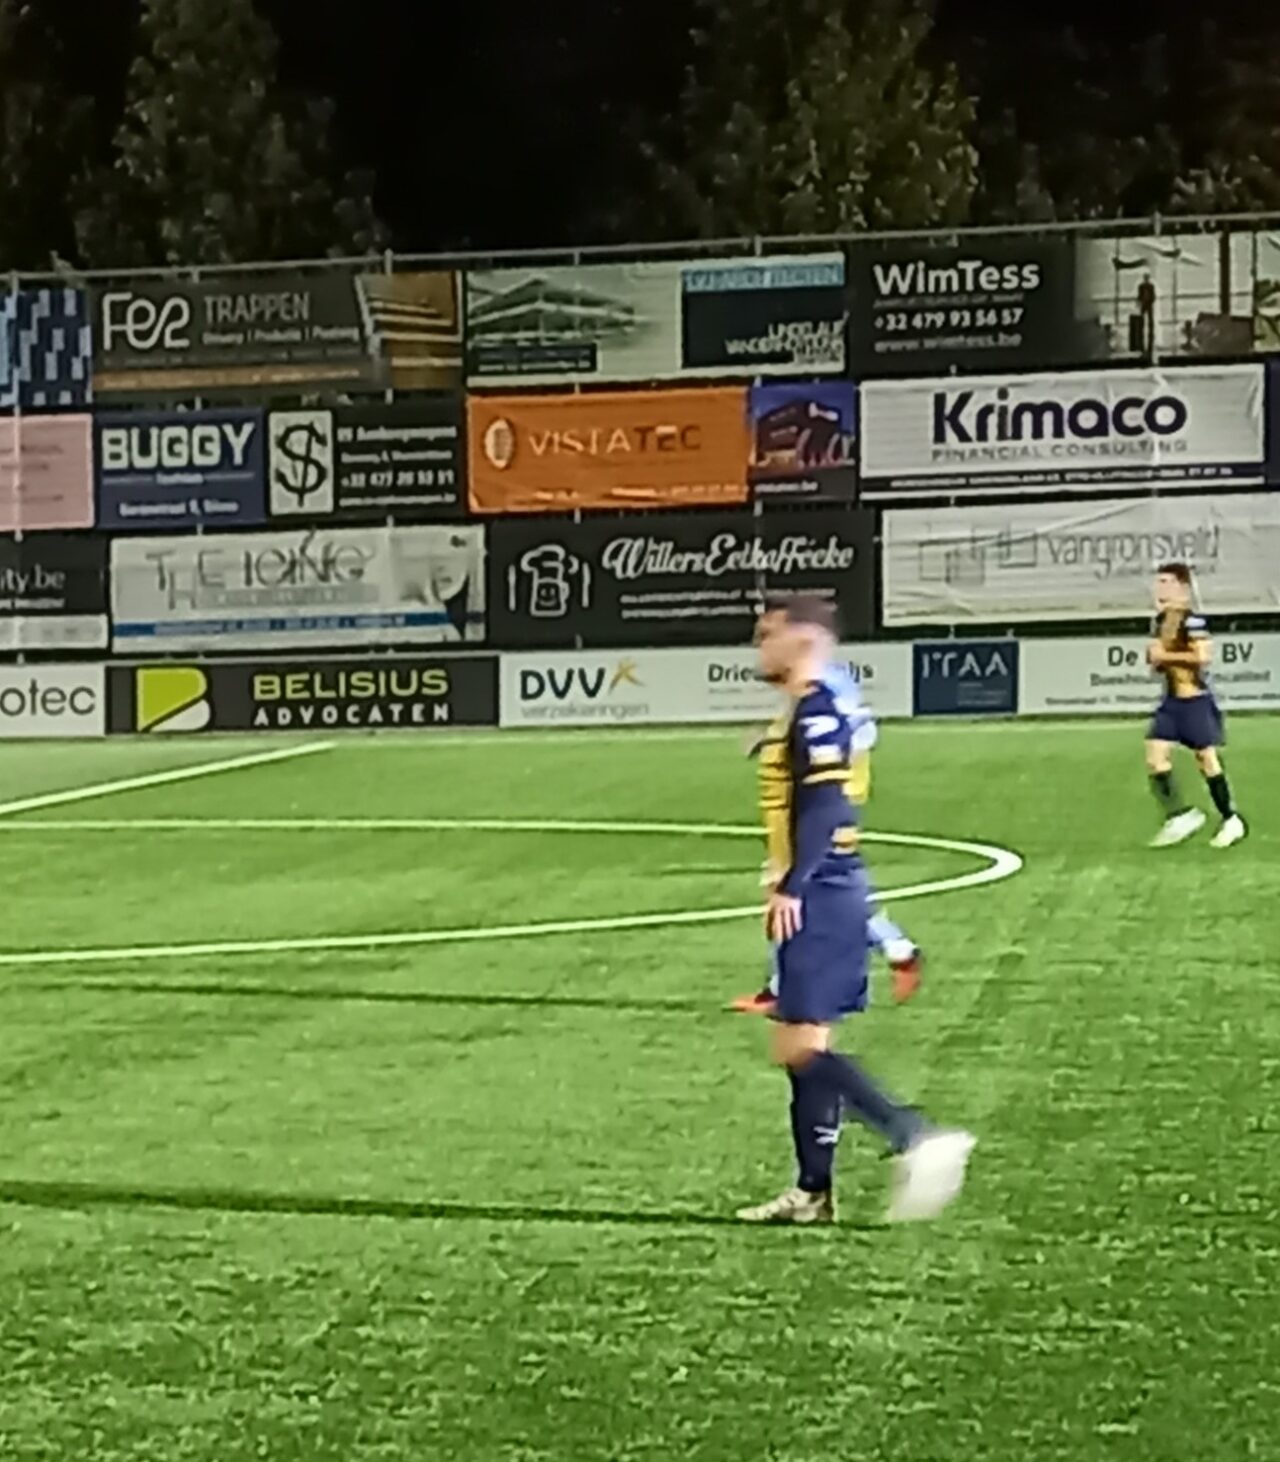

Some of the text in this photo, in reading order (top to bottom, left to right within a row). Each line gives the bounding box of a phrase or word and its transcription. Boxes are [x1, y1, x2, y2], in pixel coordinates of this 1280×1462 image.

[873, 260, 1041, 295] WimTess
[204, 292, 311, 324] TRAPPEN
[874, 313, 908, 331] +32
[911, 311, 946, 330] 479
[932, 386, 1188, 445] Krimaco
[102, 422, 256, 470] BUGGY
[932, 438, 1188, 462] FINANCIAL CONSULTING
[602, 534, 705, 580] Willers
[920, 650, 1009, 679] ITAA
[1107, 643, 1254, 668] De BV
[253, 668, 449, 701] BELISIUS
[520, 667, 607, 701] DVV
[253, 702, 450, 727] ADVOCATEN
